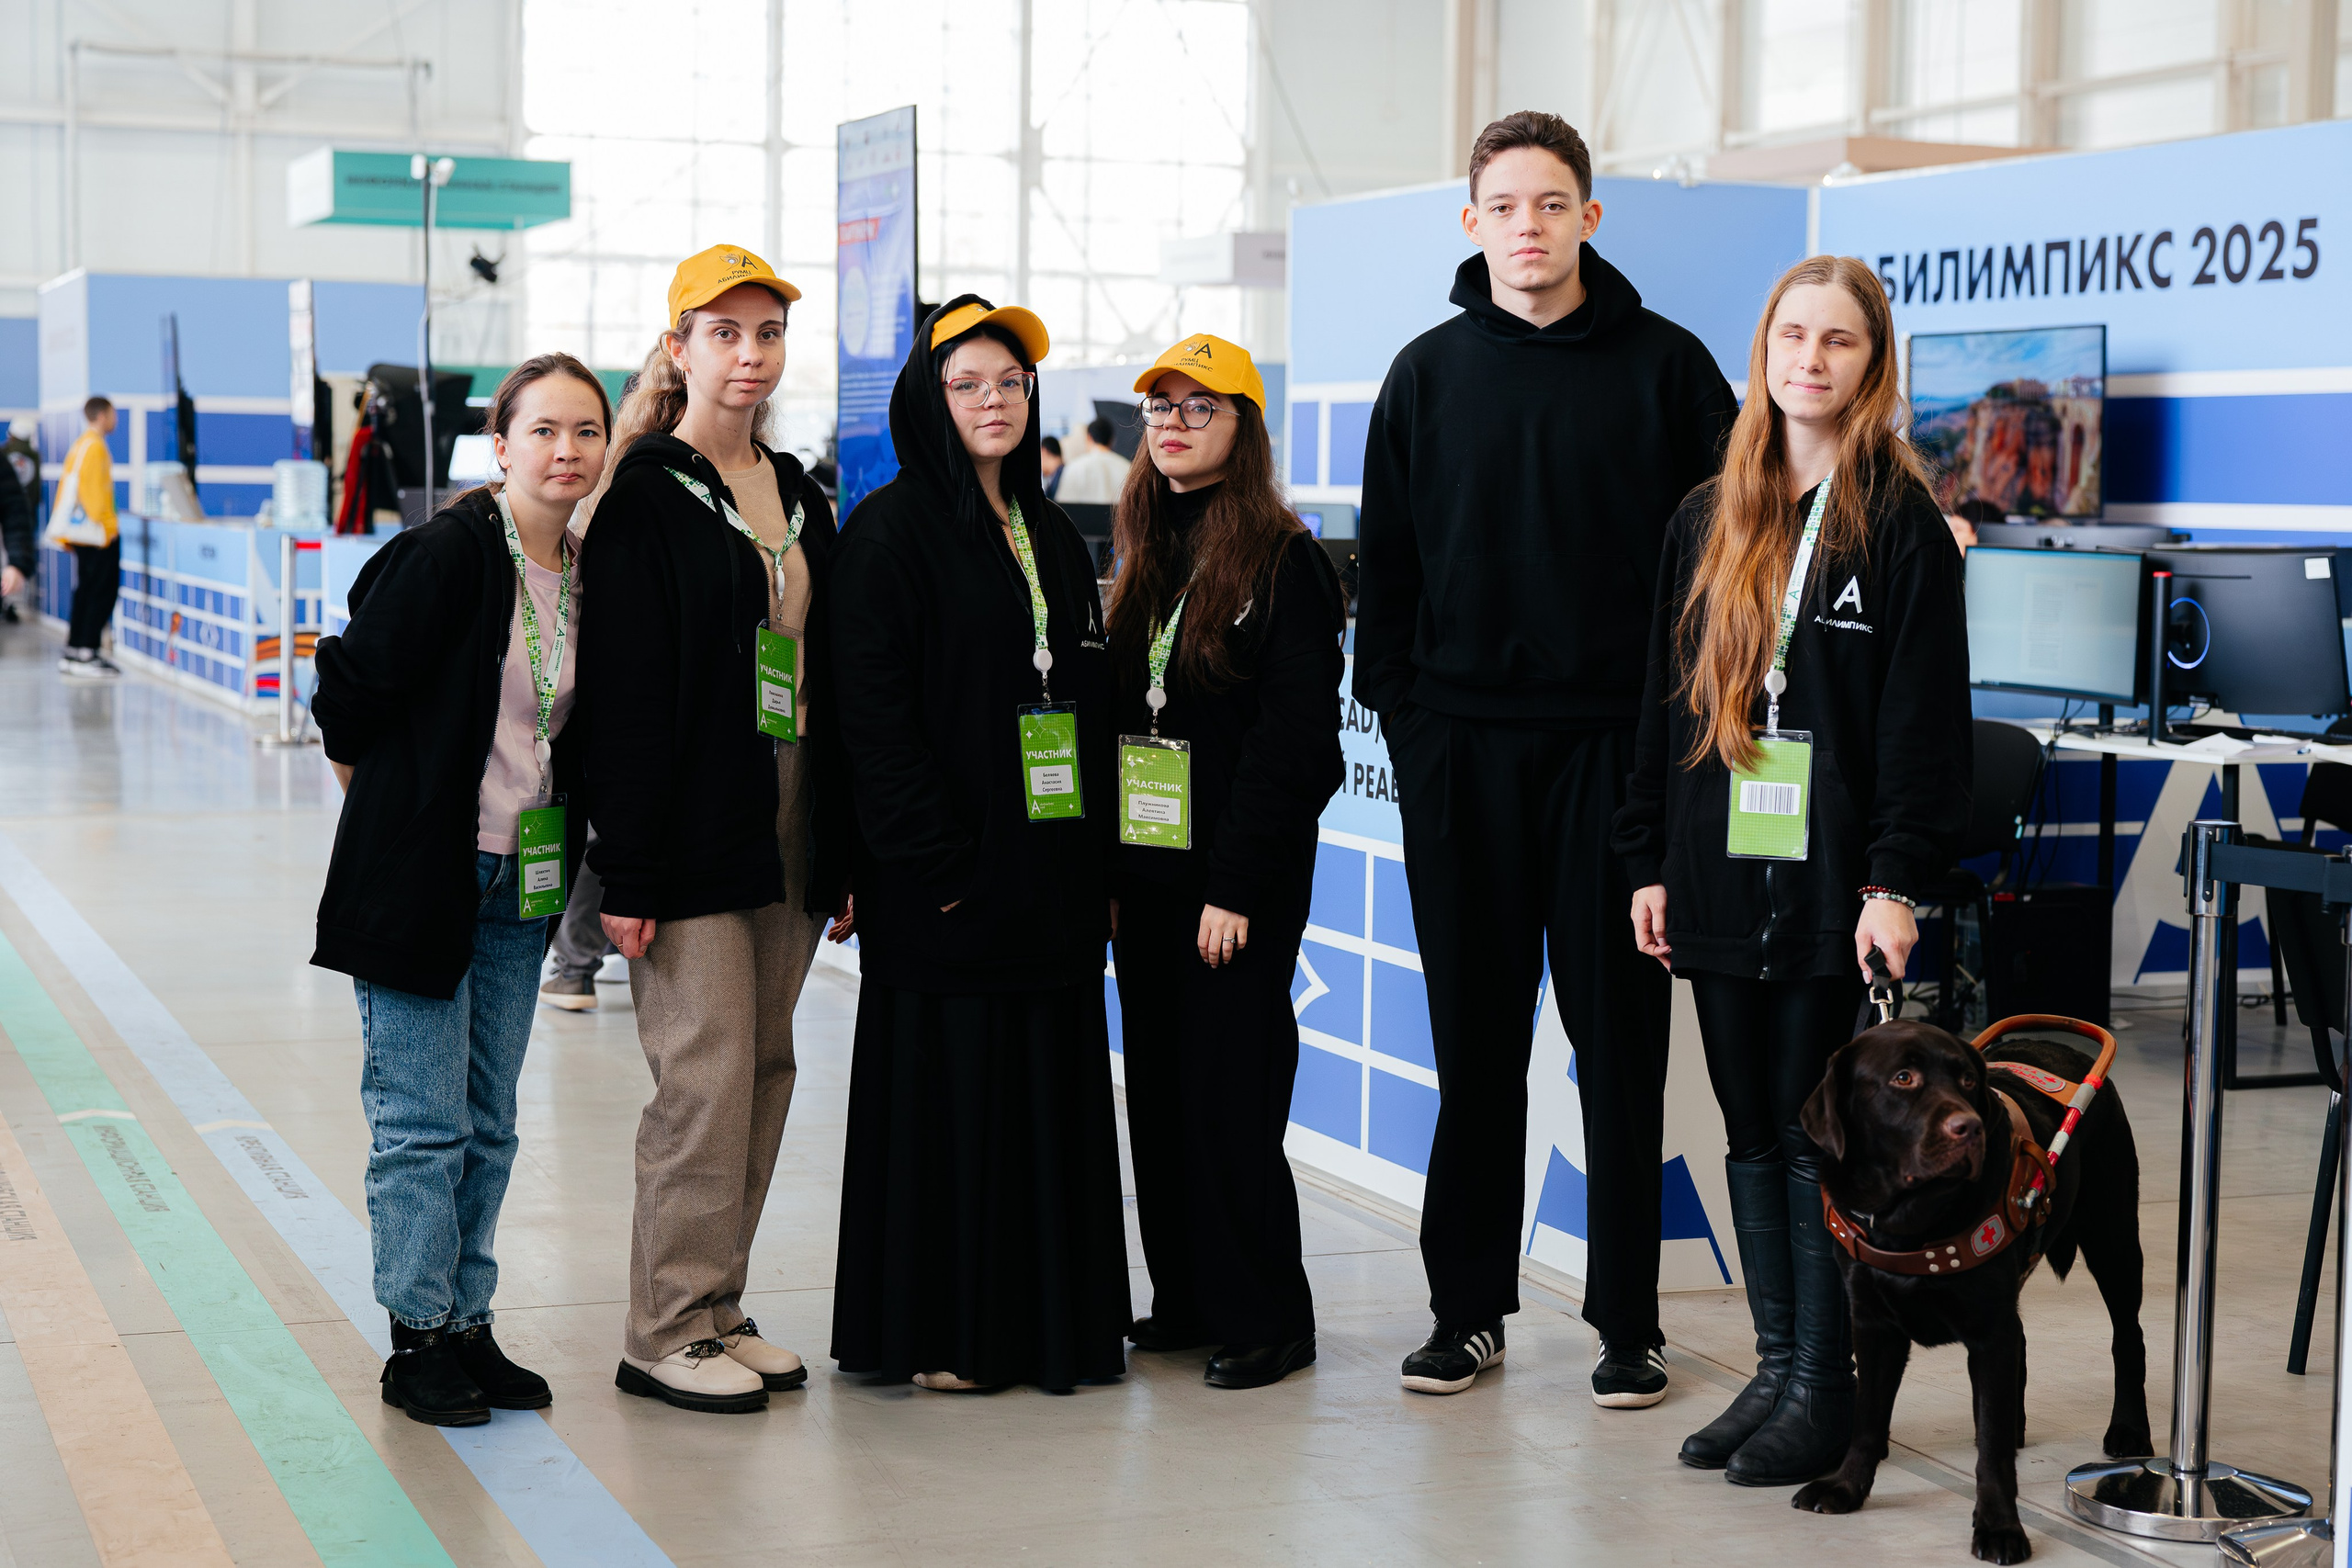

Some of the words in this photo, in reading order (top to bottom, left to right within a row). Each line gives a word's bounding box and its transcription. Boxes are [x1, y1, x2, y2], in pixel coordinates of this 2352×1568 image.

[1879, 231, 2173, 304] БИЛИМПИКС
[2191, 218, 2319, 286] 2025
[760, 663, 793, 683] УЧАСТНИК
[1026, 749, 1073, 761] УЧАСТНИК
[1126, 778, 1182, 793] УЧАСТНИК
[523, 843, 561, 857] УЧАСТНИК
